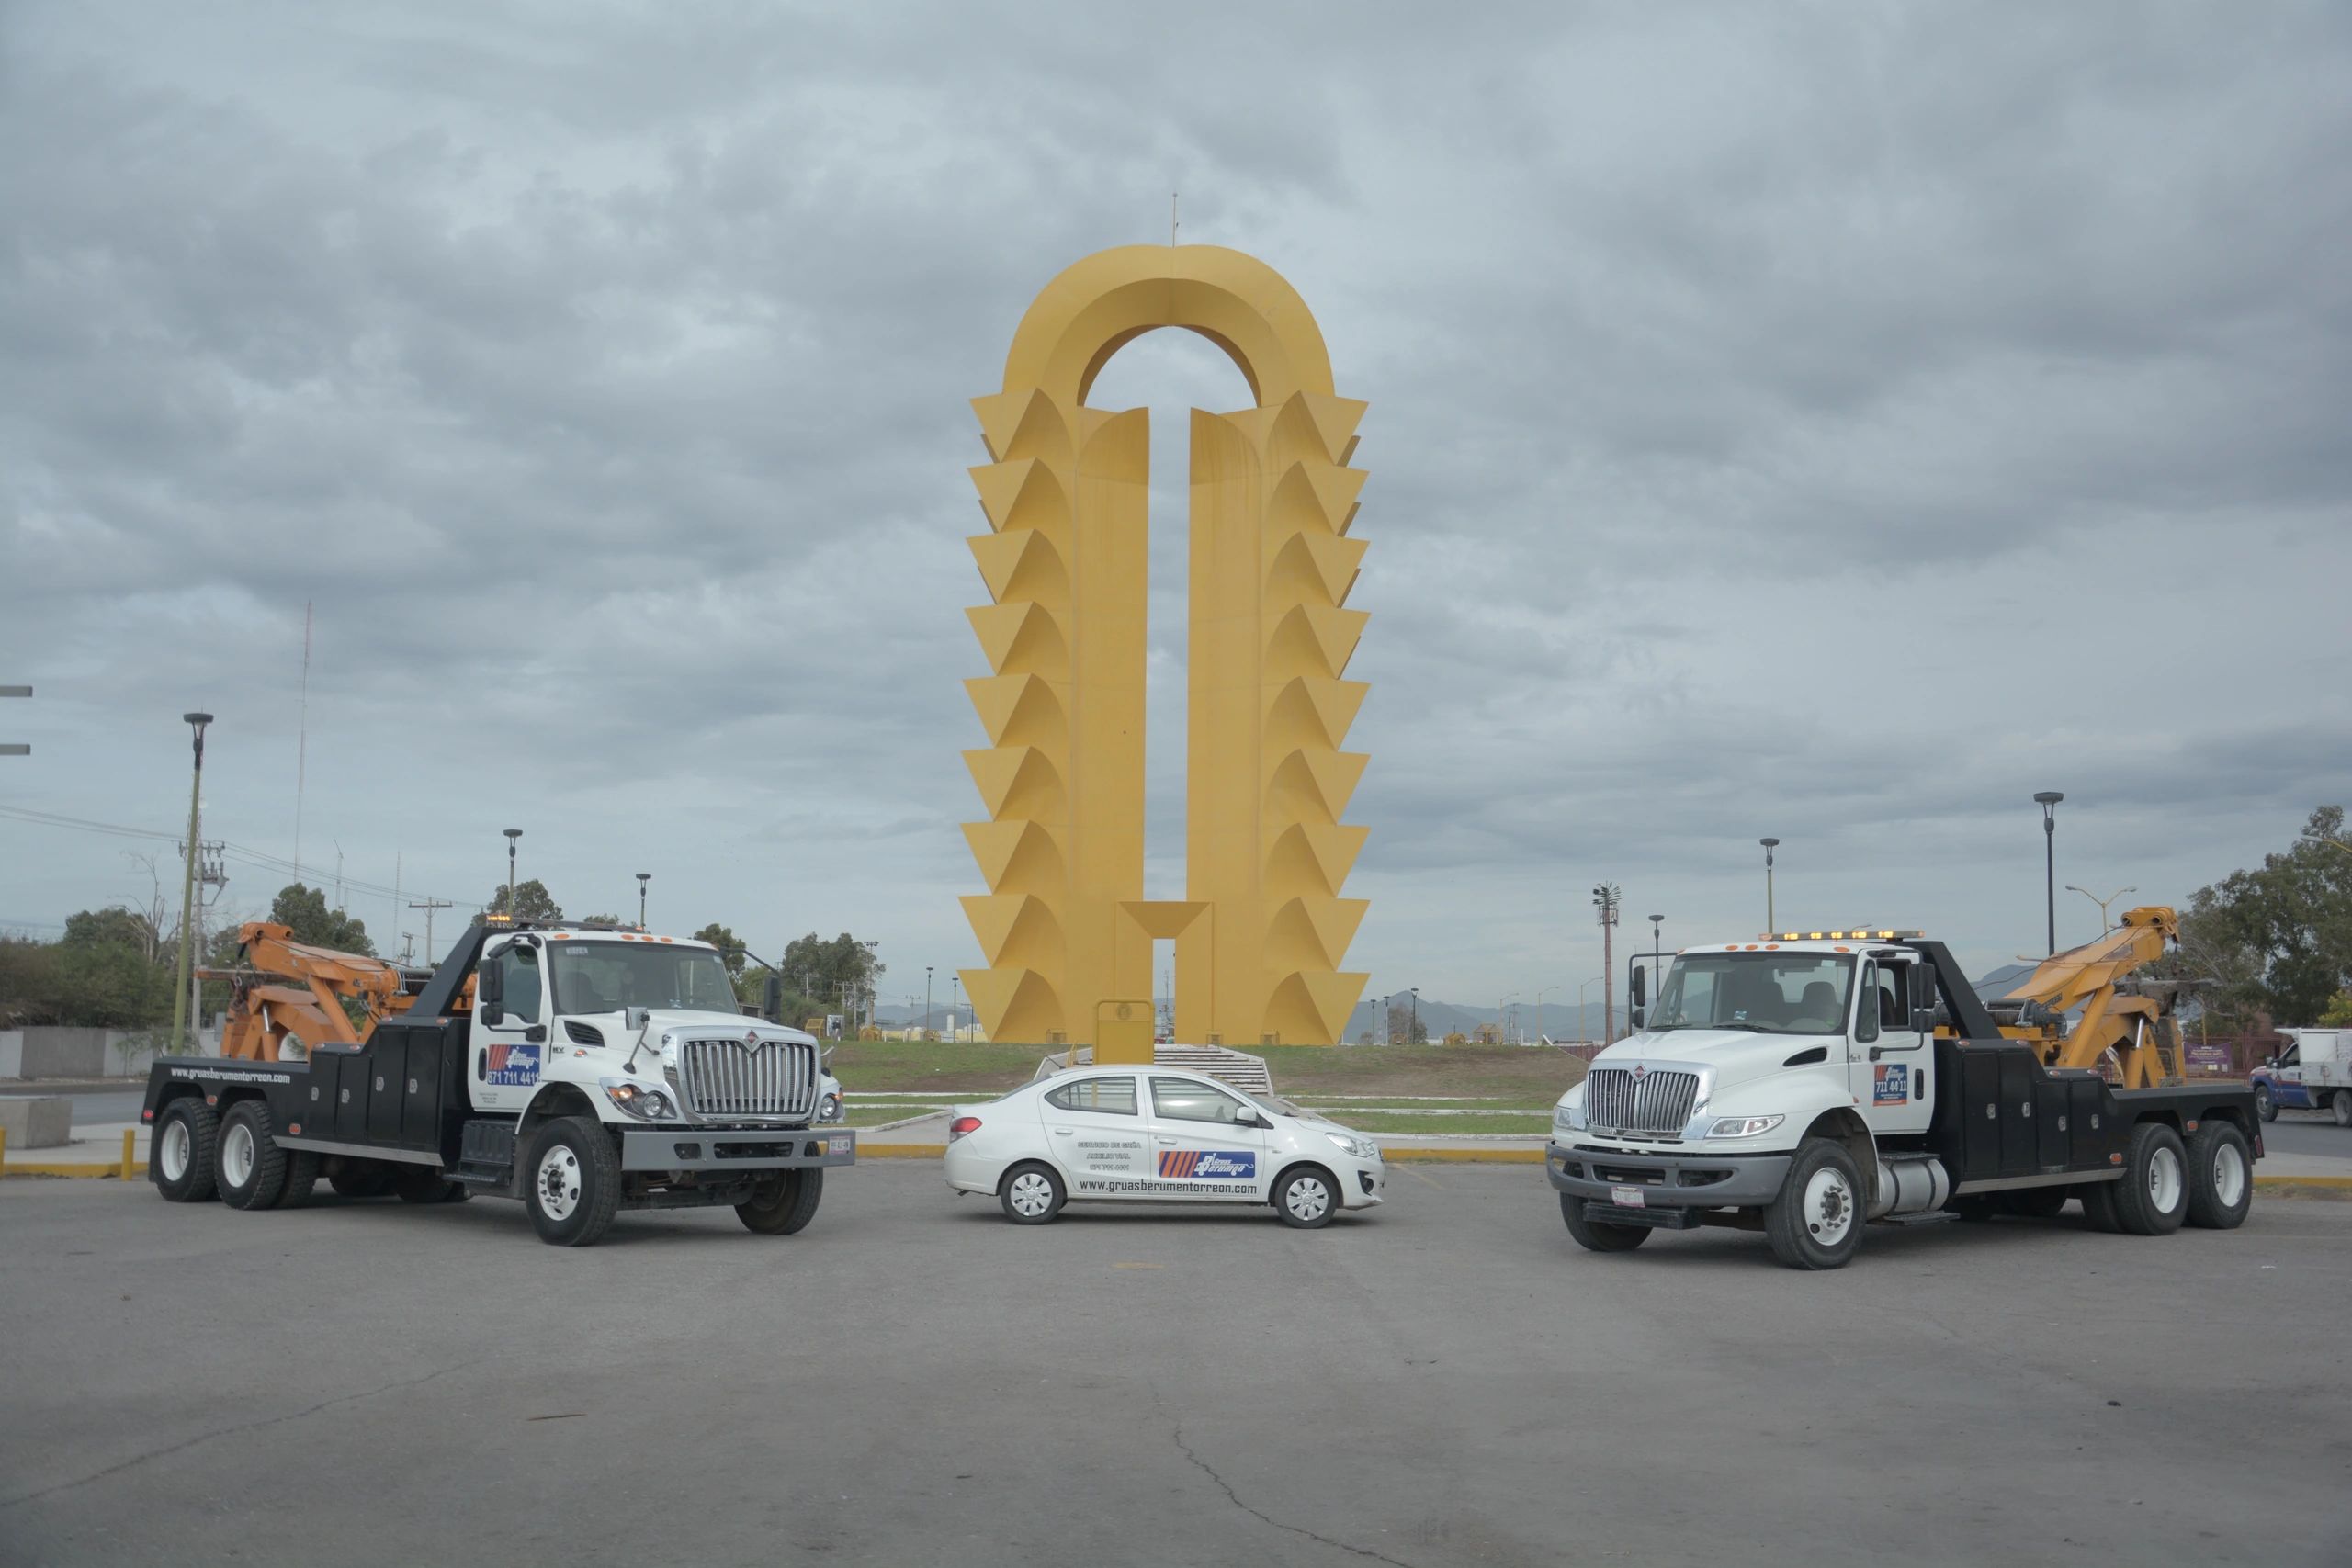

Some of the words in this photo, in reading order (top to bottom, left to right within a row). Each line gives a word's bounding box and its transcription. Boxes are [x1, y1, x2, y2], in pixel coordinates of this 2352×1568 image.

[171, 1067, 290, 1084] www.gruasberumentorreon.com
[488, 1071, 502, 1084] 871
[504, 1071, 518, 1084] 711
[520, 1072, 539, 1084] 4411
[1876, 1081, 1888, 1093] 711
[1889, 1080, 1898, 1092] 44
[1899, 1080, 1906, 1091] 11
[1080, 1179, 1257, 1193] www.gruasberumentorreon.com
